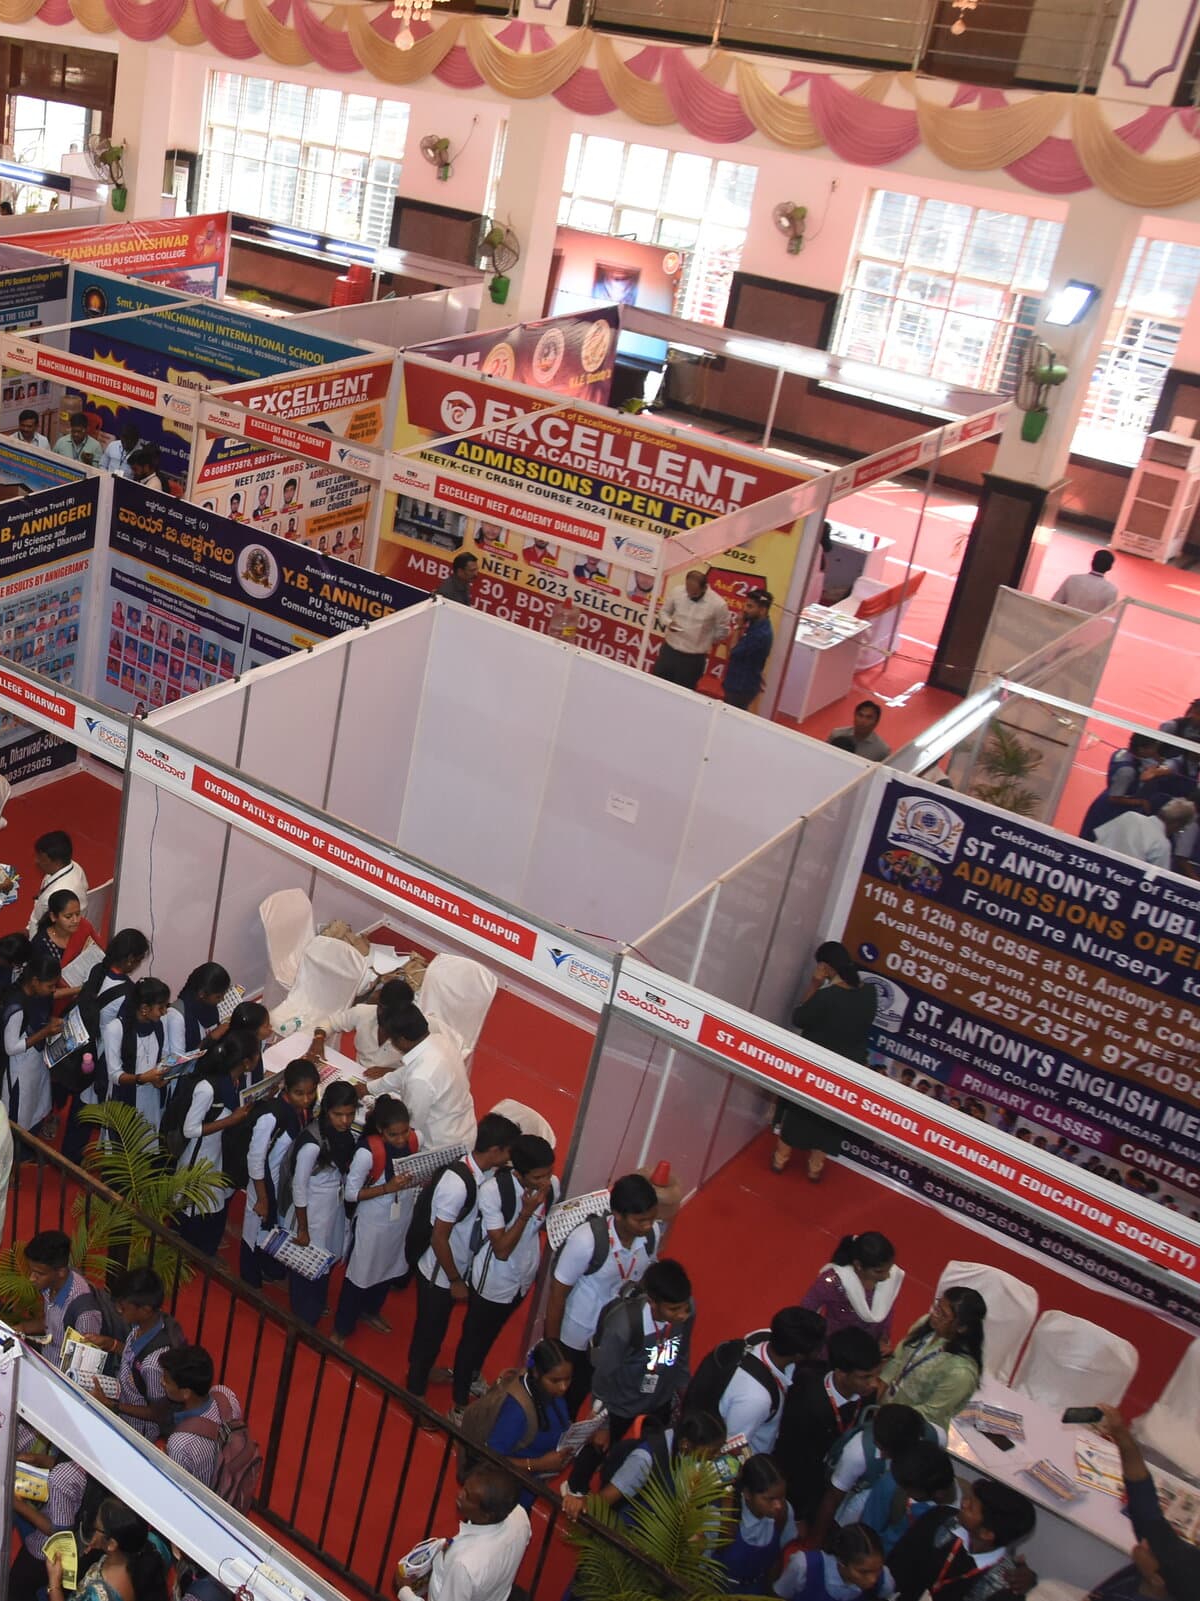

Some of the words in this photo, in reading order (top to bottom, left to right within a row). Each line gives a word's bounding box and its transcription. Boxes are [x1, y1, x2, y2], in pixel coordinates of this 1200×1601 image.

[53, 235, 189, 261] CHANNABASAVESHWAR
[124, 254, 153, 265] SCIENCE
[155, 250, 186, 261] COLLEGE
[216, 325, 286, 354] INTERNATIONAL
[288, 346, 325, 364] SCHOOL
[249, 374, 373, 413] EXCELLENT
[234, 475, 254, 488] NEET
[255, 470, 275, 483] 2023
[282, 462, 304, 476] MBBS
[455, 442, 593, 496] ADMISSIONS
[600, 485, 664, 518] OPEN
[480, 428, 531, 453] NEET
[534, 444, 631, 487] ACADEMY,
[483, 400, 757, 502] EXCELLENT
[420, 452, 482, 481] NEET/K-CET
[486, 471, 523, 490] CRASH
[527, 483, 573, 506] COURSE
[576, 499, 606, 516] 2024
[614, 512, 644, 528] NEET
[439, 484, 484, 506] EXCELLENT
[486, 498, 508, 513] NEET
[509, 505, 553, 527] ACADEMY
[554, 518, 600, 542] DHARWAD
[20, 503, 92, 536] ANNIGERI
[23, 532, 52, 548] Science
[29, 542, 55, 559] College
[57, 531, 86, 549] Dharwad
[5, 578, 34, 597] RESULTS
[305, 565, 337, 583] Annigeri
[338, 576, 357, 589] Seva
[358, 582, 379, 598] Trust
[481, 557, 523, 581] NEET
[527, 574, 567, 598] 2023
[24, 688, 66, 717] DHARWAD
[204, 780, 240, 806] OXFORD
[242, 799, 275, 824] PATIL'S
[277, 817, 310, 841] GROUP
[312, 837, 326, 849] OF
[328, 844, 383, 879] EDUCATION
[386, 871, 460, 916] NAGARABETTA
[472, 913, 520, 945] BIJAPUR
[963, 837, 996, 865] ST.
[1000, 851, 1121, 912] ANTONY'S
[991, 825, 1063, 862] Celebrating
[1067, 854, 1101, 875] 35th
[1105, 865, 1136, 886] Year
[953, 861, 1127, 941] ADMISSIONS
[863, 883, 899, 908] 11th
[921, 905, 956, 933] 12th
[959, 921, 988, 946] Std
[991, 935, 1039, 966] CBSE
[1093, 977, 1174, 1019] Antony's
[962, 889, 1021, 926] From
[1027, 915, 1067, 944] Pre
[1072, 932, 1171, 986] Nursery
[567, 965, 609, 989] EXPO
[571, 959, 610, 981] EDUCATION
[874, 911, 954, 952] Available
[958, 946, 1025, 981] Stream
[1040, 978, 1128, 1023] SCIENCE
[899, 939, 991, 986] Synergised
[995, 981, 1033, 1004] with
[1037, 997, 1101, 1030] ALLEN
[617, 988, 690, 1031] ವಿಜಯವಾಣಿ
[885, 952, 948, 990] 0836
[969, 991, 1092, 1056] 4257357,
[912, 1000, 943, 1030] ST.
[946, 1017, 1057, 1078] ANTONY'S
[1056, 1063, 1161, 1123] ENGLISH
[961, 1074, 1028, 1113] PRIMARY
[1032, 1105, 1104, 1145] CLASSES
[716, 1030, 735, 1048] ST.
[738, 1041, 804, 1079] ANTHONY
[805, 1073, 858, 1104] PUBLIC
[861, 1099, 920, 1134] SCHOOL
[923, 1129, 1017, 1181] (VELANGANI
[1018, 1176, 1112, 1228] EDUCATION
[1114, 1221, 1196, 1269] SOCIETY)
